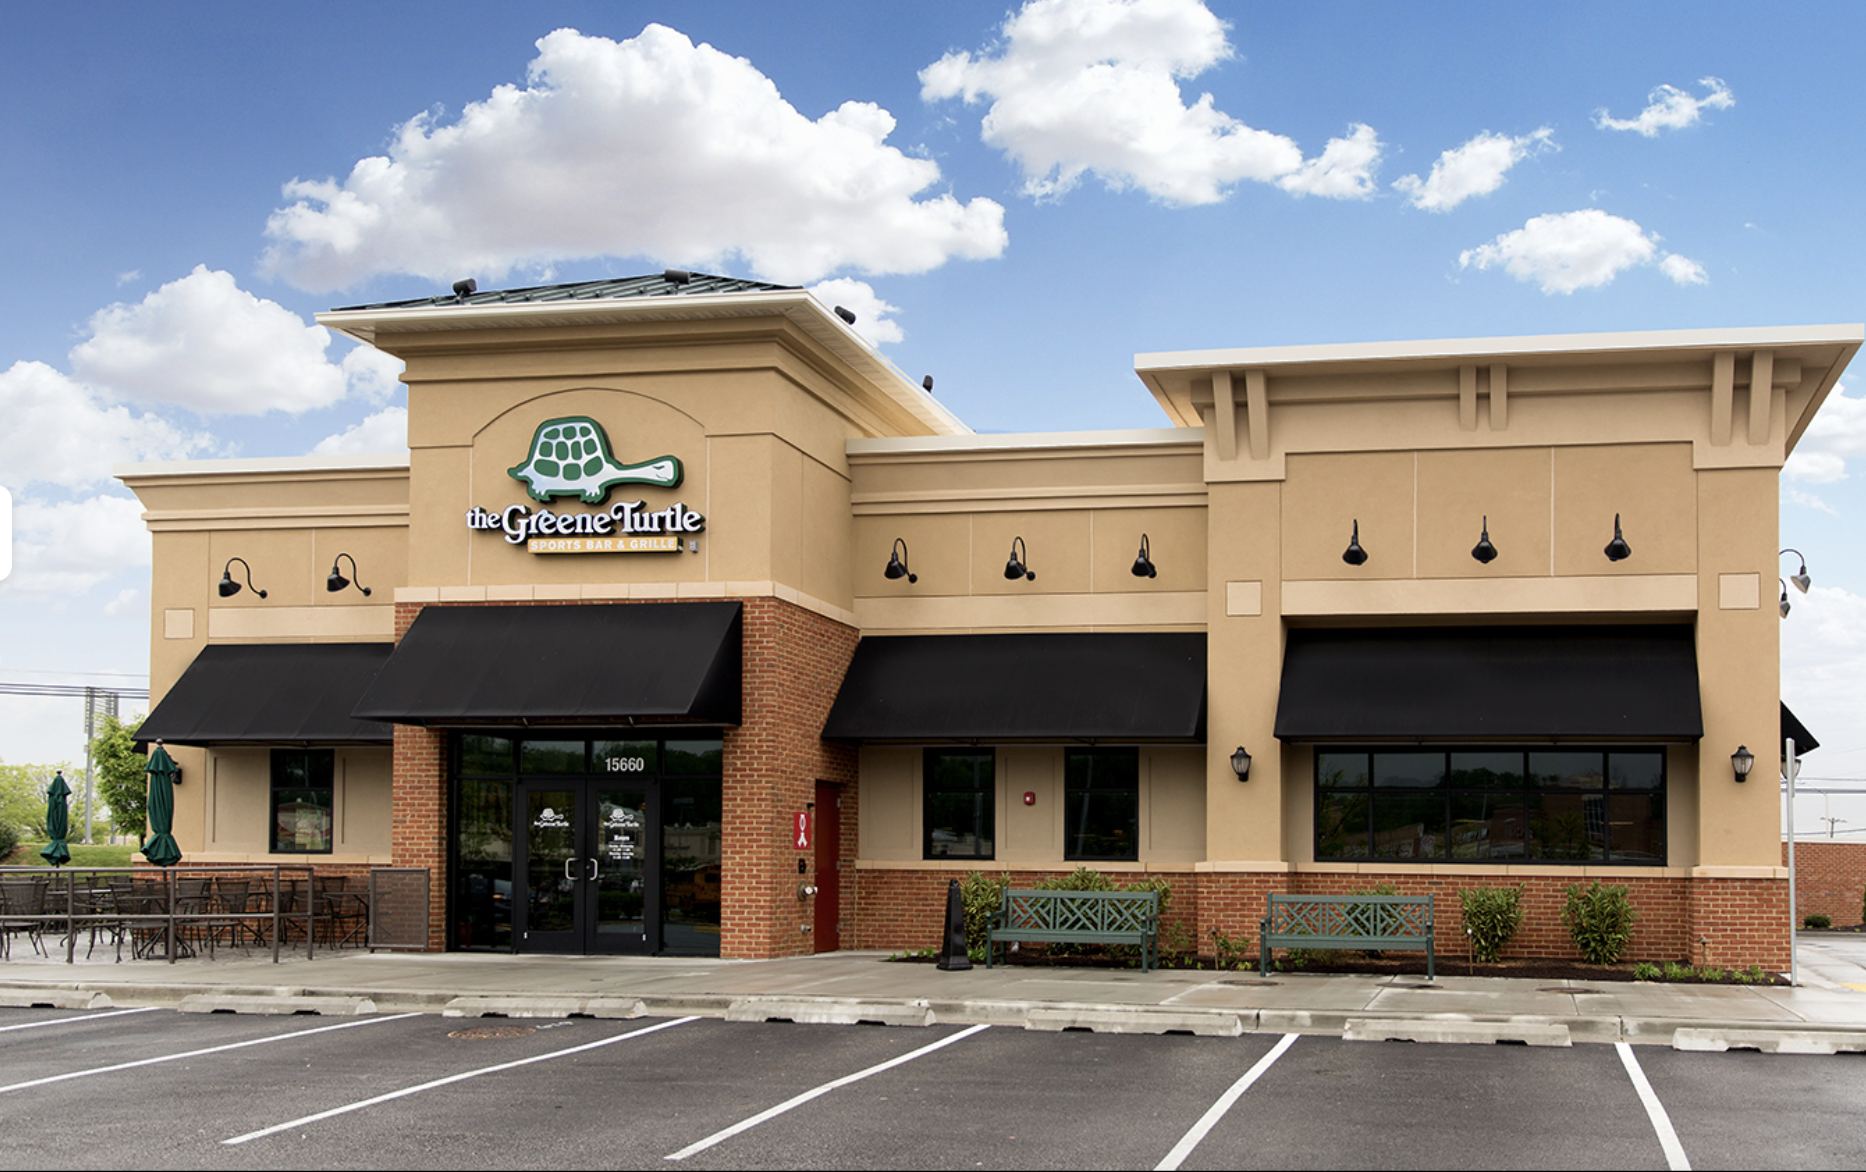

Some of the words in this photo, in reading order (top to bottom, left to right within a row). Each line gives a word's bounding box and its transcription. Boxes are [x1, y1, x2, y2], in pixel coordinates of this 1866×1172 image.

[465, 506, 501, 529] the
[502, 504, 614, 544] Greene
[610, 499, 703, 532] Turtle
[530, 539, 582, 551] SPORTS
[586, 539, 612, 550] BAR
[616, 539, 625, 550] &
[629, 538, 676, 550] GRILLE
[605, 757, 645, 772] 15660
